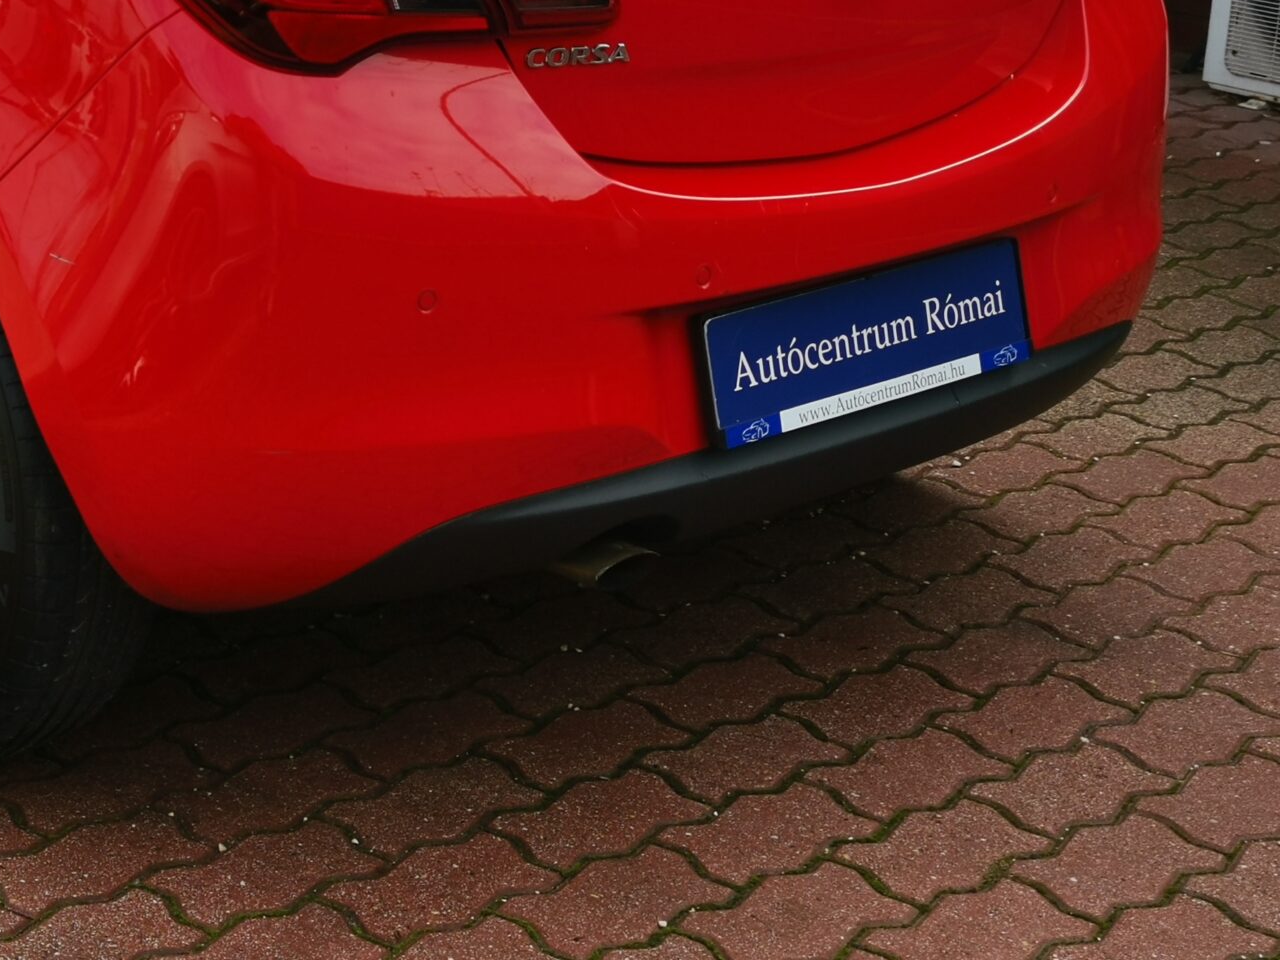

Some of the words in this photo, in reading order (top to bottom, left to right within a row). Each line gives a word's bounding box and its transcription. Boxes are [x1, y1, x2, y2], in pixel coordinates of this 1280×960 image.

[525, 42, 630, 70] CORSA
[733, 315, 918, 392] Autócentrum
[922, 279, 1006, 336] Római
[798, 362, 966, 425] www.AutócentrumRómai.hu
